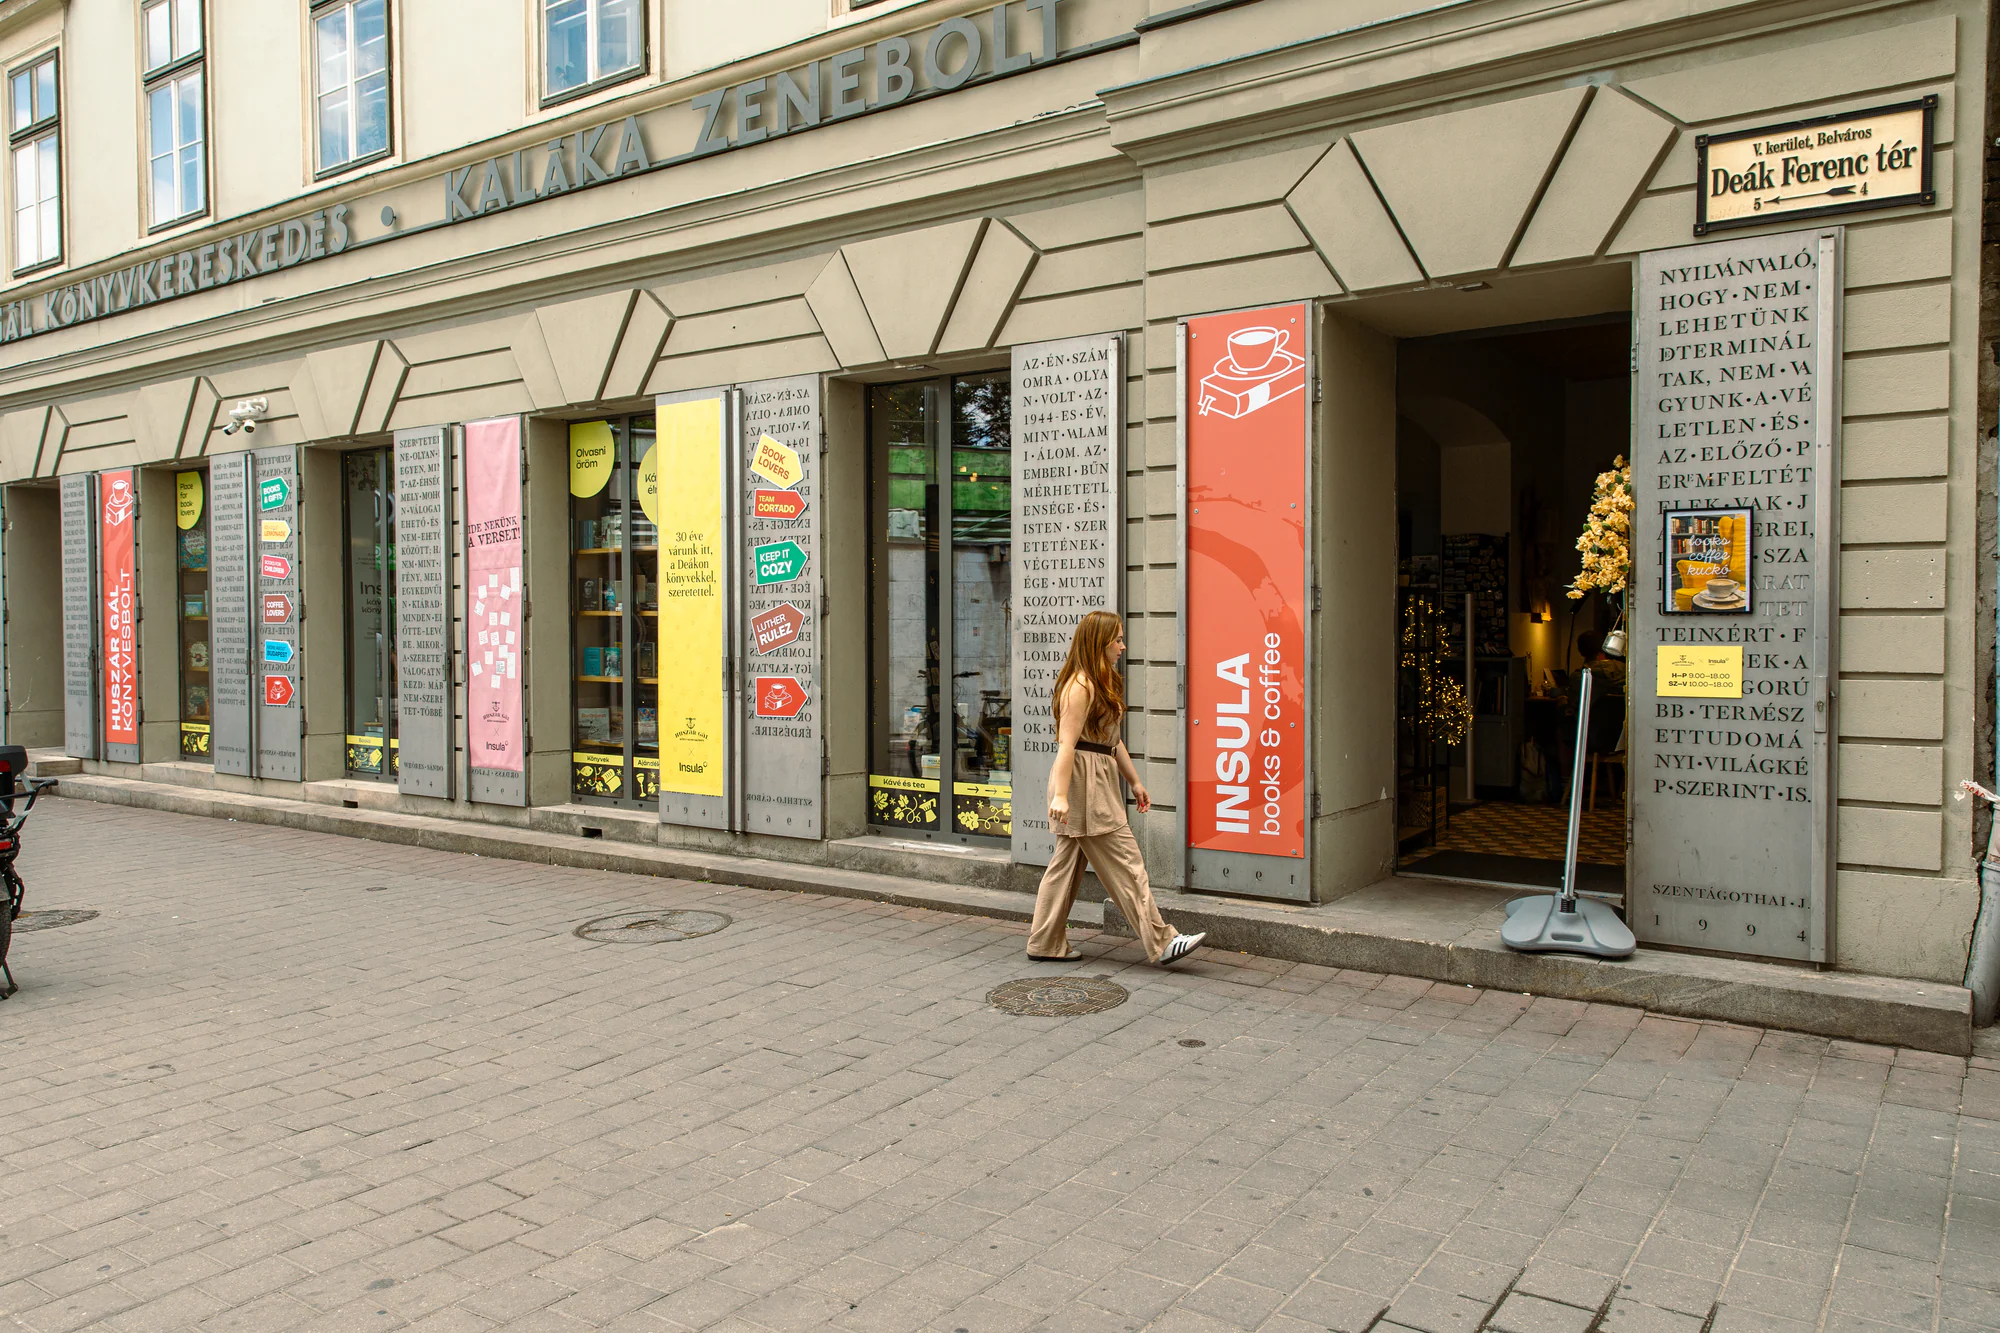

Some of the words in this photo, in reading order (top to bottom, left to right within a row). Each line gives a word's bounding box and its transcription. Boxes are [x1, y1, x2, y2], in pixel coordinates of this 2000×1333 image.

[445, 114, 651, 223] KALÁKA
[691, 0, 1062, 155] ZENEBOLT
[1753, 143, 1763, 156] V.
[1765, 136, 1814, 156] kerület,
[1817, 126, 1872, 147] Belváros
[1711, 161, 1775, 197] Deák
[1781, 154, 1869, 188] Ferenc
[1876, 139, 1918, 171] tér
[1859, 182, 1869, 196] 4
[1753, 197, 1762, 211] 5
[0, 300, 34, 342] ÁL
[44, 204, 349, 330] KÖNYVKERESKEDÉS
[1660, 248, 1817, 286] NYILVÁNVALÓ,
[1660, 289, 1728, 311] HOGY
[1743, 280, 1801, 301] NEM
[1659, 306, 1809, 336] LEHETÜNK
[1658, 369, 1711, 388] TAK,
[1720, 363, 1775, 383] NEM
[1790, 360, 1812, 376] VA
[1658, 392, 1743, 413] GYUNK
[1780, 382, 1812, 402] VÉ
[1658, 418, 1755, 439] LETLEN
[1771, 411, 1799, 431] ÉS
[576, 446, 606, 458] Olvasni
[762, 445, 786, 464] BOOK
[1657, 449, 1687, 465] AZ
[1701, 438, 1782, 461] ELŐZŐ
[576, 459, 598, 470] öröm
[758, 456, 790, 480] LOVERS
[263, 484, 281, 495] BOOKS
[268, 492, 283, 502] GIFTS
[1023, 482, 1109, 498] MÉRHETETL
[758, 504, 795, 513] CORTADO
[484, 516, 517, 531] NEKÜNK
[468, 537, 475, 548] A
[478, 527, 521, 545] VERSET!
[675, 532, 687, 542] 30
[689, 530, 704, 542] éve
[1023, 537, 1099, 553] ETETÉNEK
[668, 542, 699, 556] várunk
[701, 543, 713, 556] itt,
[760, 551, 780, 562] KEEP
[782, 549, 790, 558] IT
[1689, 549, 1731, 564] coffee
[670, 561, 676, 569] a
[677, 557, 709, 570] Deákon
[761, 560, 793, 577] COZY
[1023, 556, 1106, 571] VÉGTELENS
[1687, 563, 1731, 576] kuckó
[666, 570, 717, 586] könyvekkel,
[668, 584, 715, 598] szeretettel.
[107, 585, 120, 631] GÁL
[756, 613, 786, 633] LUTHER
[1656, 623, 1775, 643] TEINKÉRT
[759, 622, 793, 646] RULEZ
[120, 568, 133, 731] KÖNYVESBOLT
[109, 637, 121, 730] HUSZÁR
[1259, 632, 1281, 720] coffee
[1700, 702, 1805, 723] TERMÉSZ
[486, 741, 505, 752] Insula
[1216, 652, 1250, 834] INSULA
[1260, 727, 1281, 748] &
[1655, 728, 1804, 749] ETTUDOMÁ
[679, 762, 704, 773] Insula
[1655, 754, 1695, 770] NYI
[1704, 753, 1809, 776] VILÁGKÉ
[883, 778, 901, 787] Kávé
[902, 779, 911, 788] és
[912, 781, 925, 789] tea
[1675, 780, 1776, 799] SZERINT
[1259, 755, 1281, 836] books
[1652, 884, 1786, 908] SZENTÁGOTHAI
